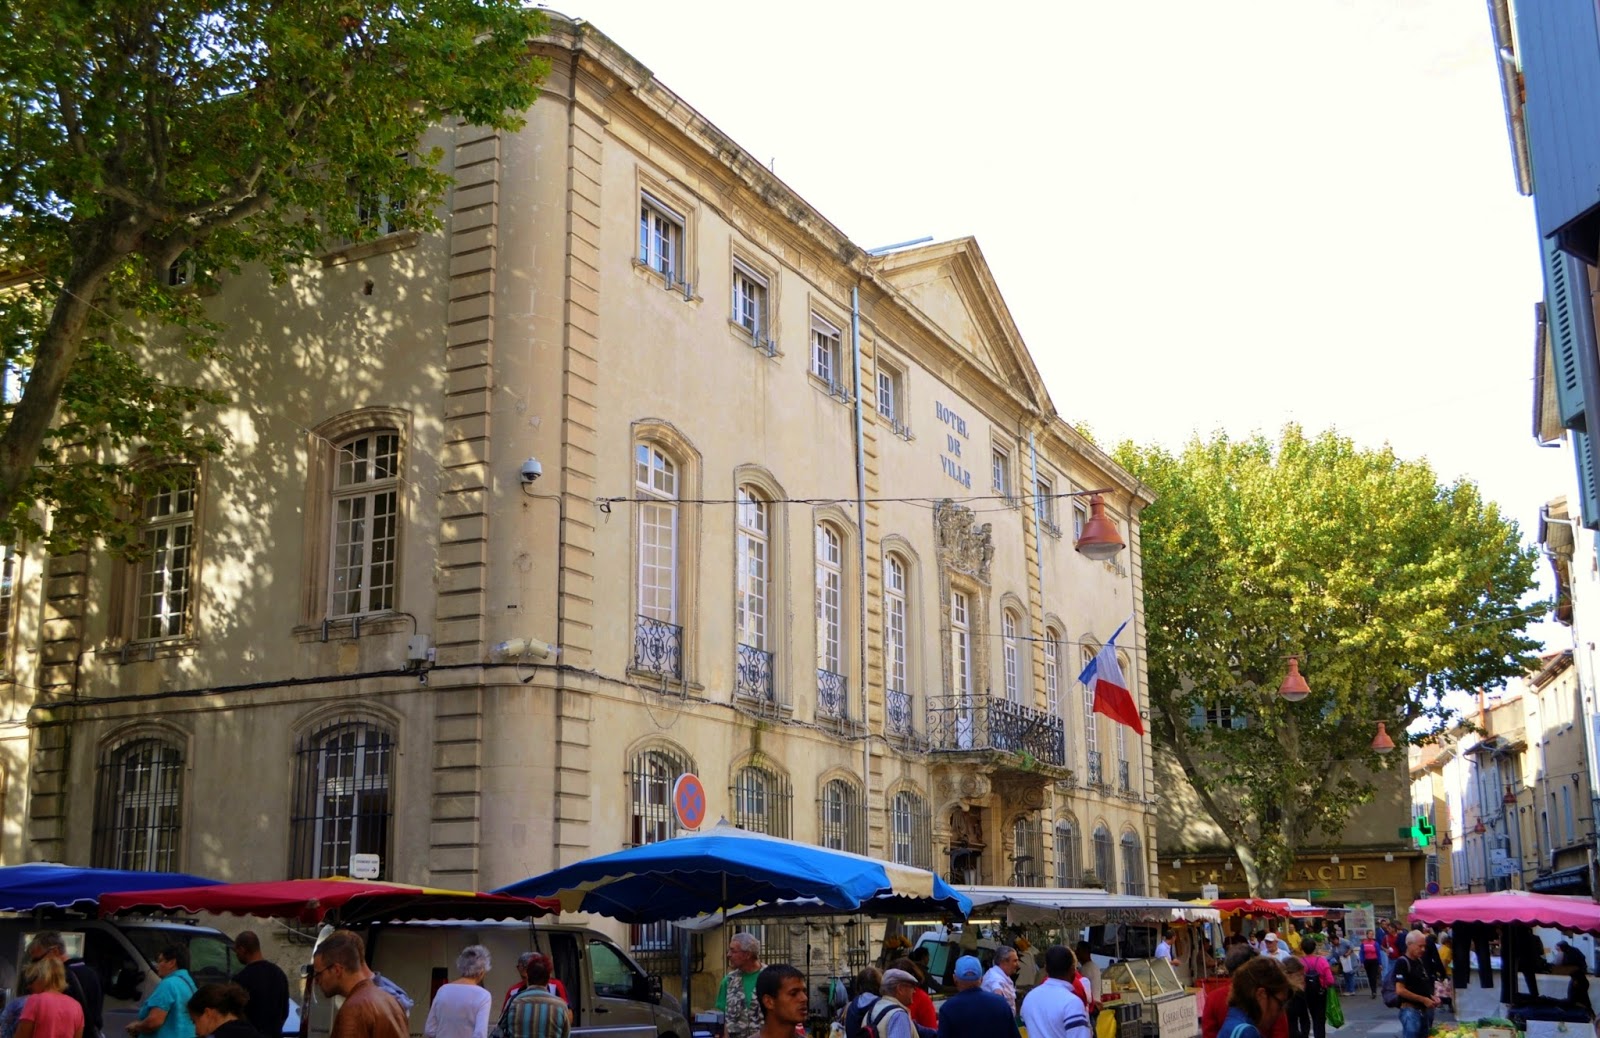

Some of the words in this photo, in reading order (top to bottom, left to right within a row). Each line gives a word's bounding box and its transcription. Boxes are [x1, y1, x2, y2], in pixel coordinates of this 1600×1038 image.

[936, 400, 969, 440] HOTEL
[947, 433, 961, 458] DE
[940, 454, 971, 490] VILLE
[1190, 864, 1367, 884] PHAACIE
